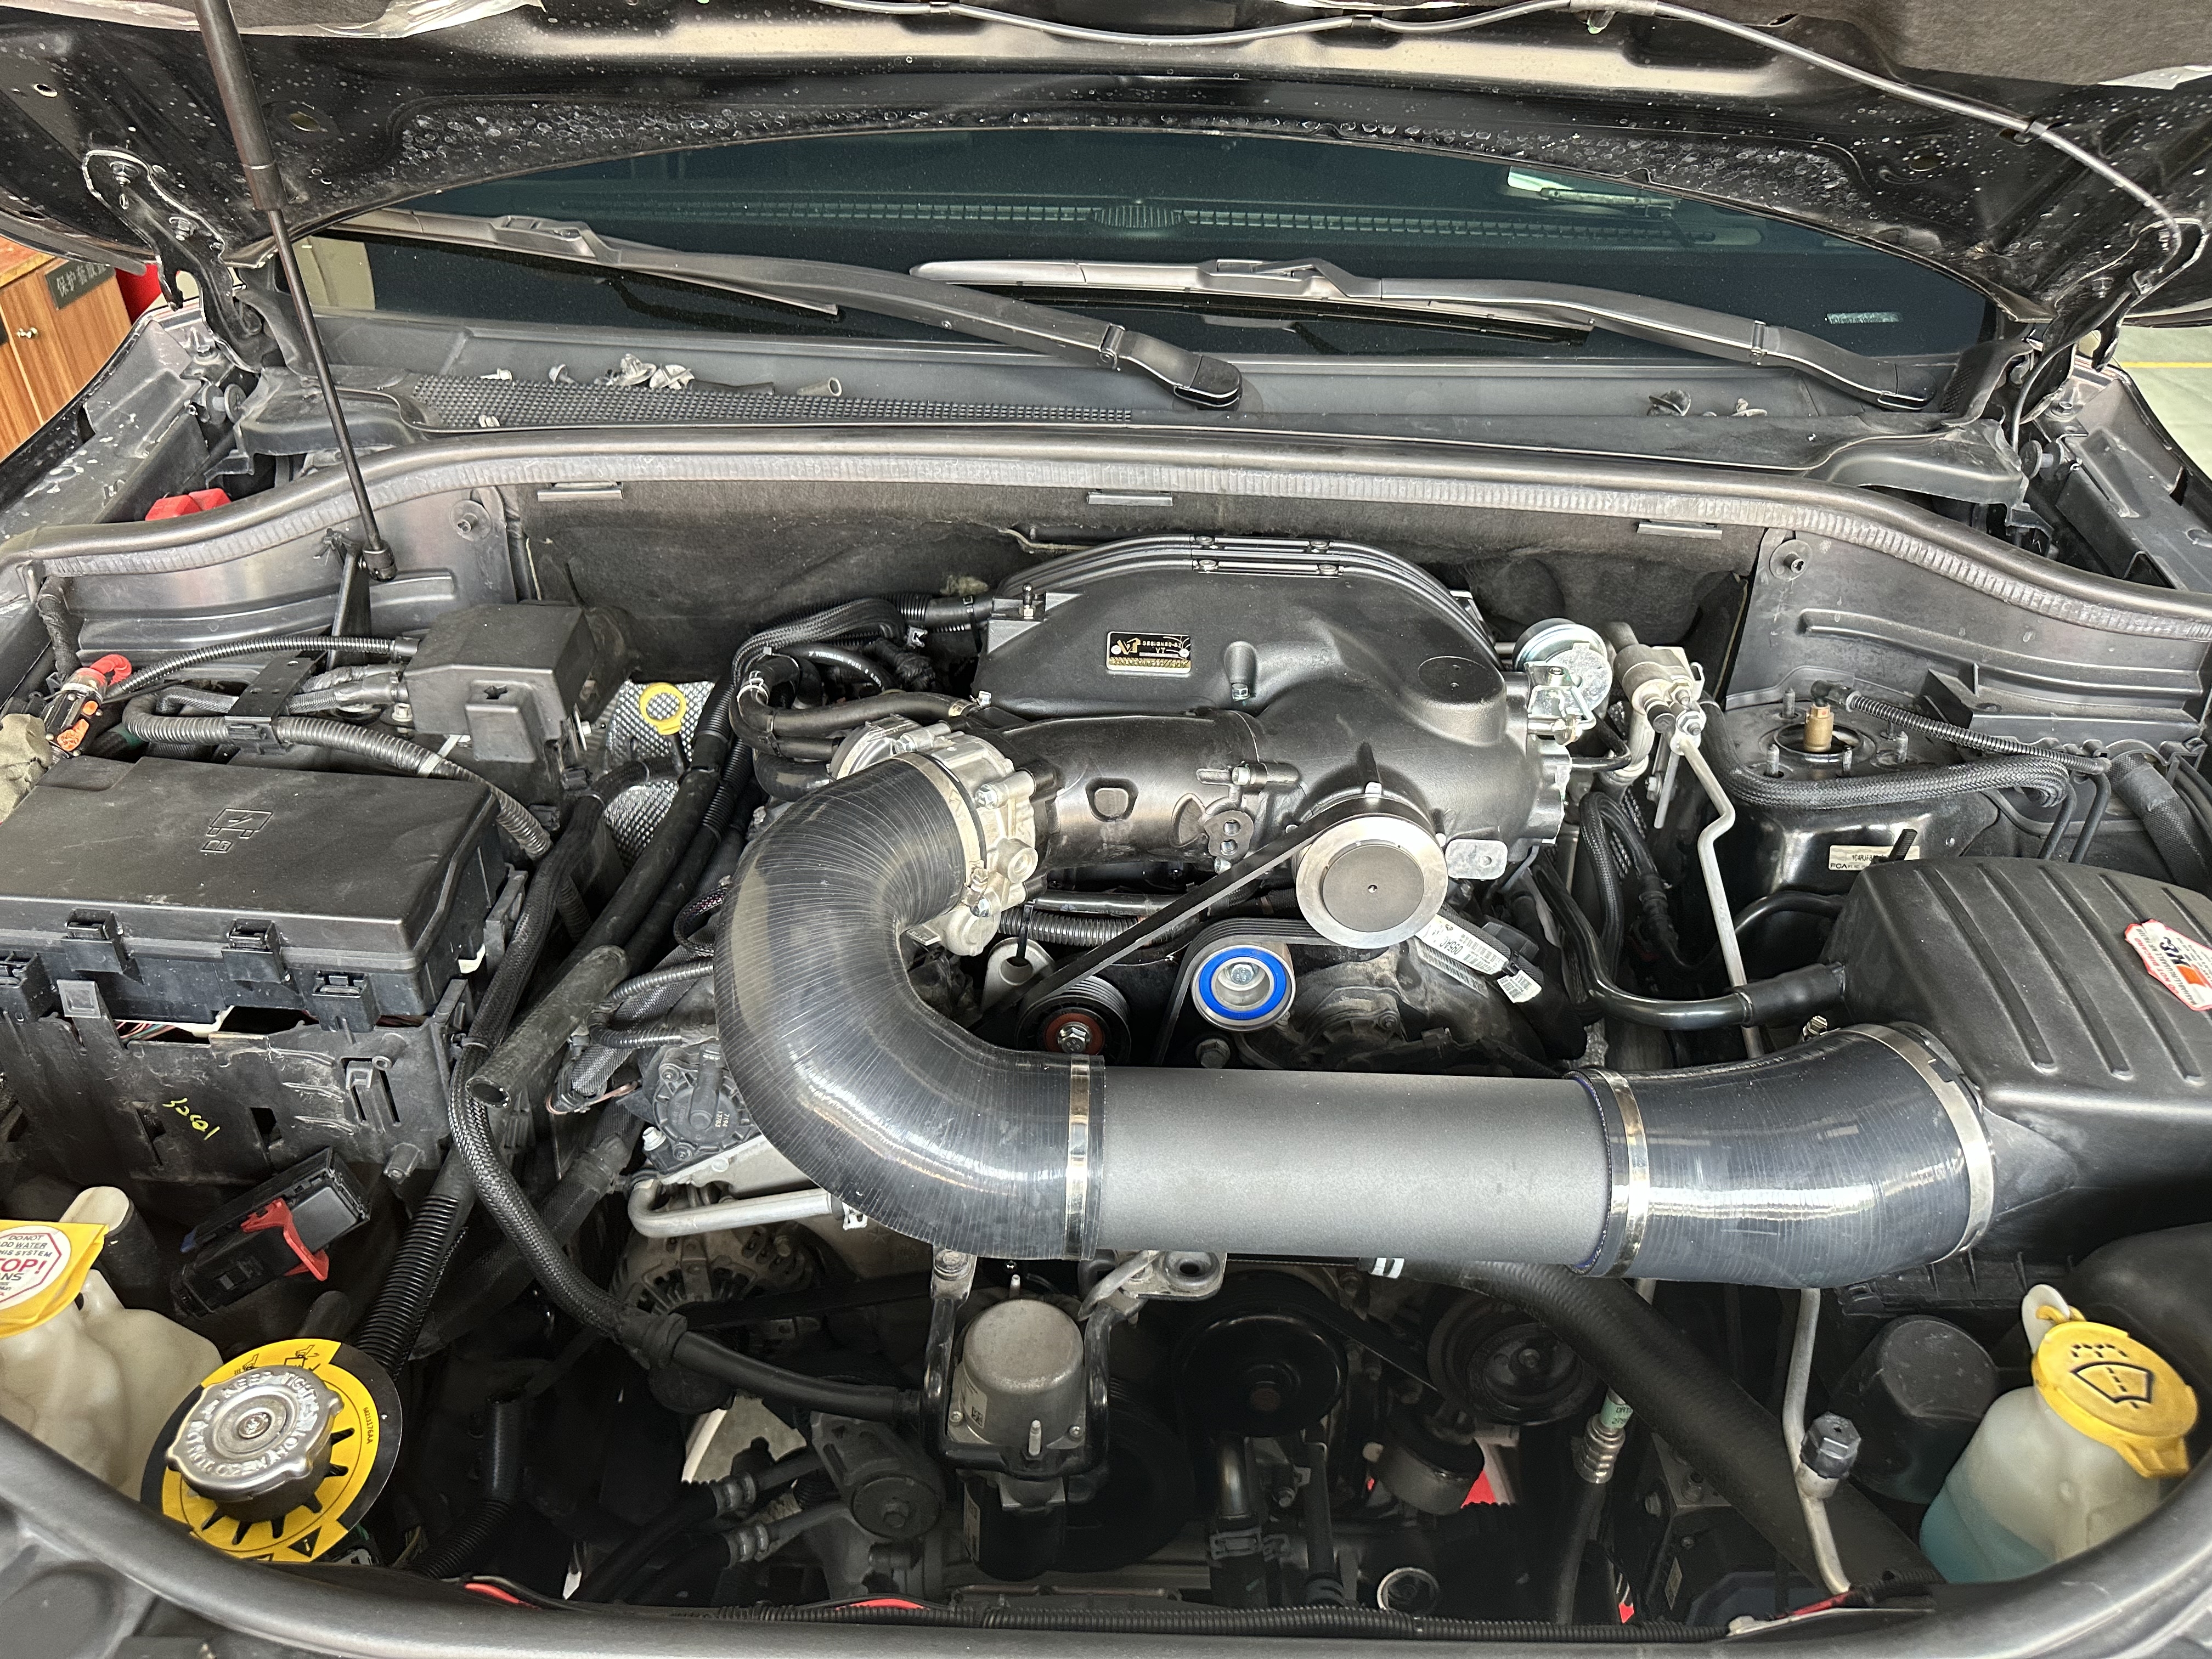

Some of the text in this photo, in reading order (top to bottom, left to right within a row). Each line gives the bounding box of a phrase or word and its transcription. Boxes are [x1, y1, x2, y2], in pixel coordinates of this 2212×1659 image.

[2134, 938, 2160, 967] DISCARD
[2157, 968, 2171, 982] NOT
[0, 1258, 48, 1274] OP!
[0, 1273, 25, 1281] NS
[220, 1372, 273, 1398] KEEP
